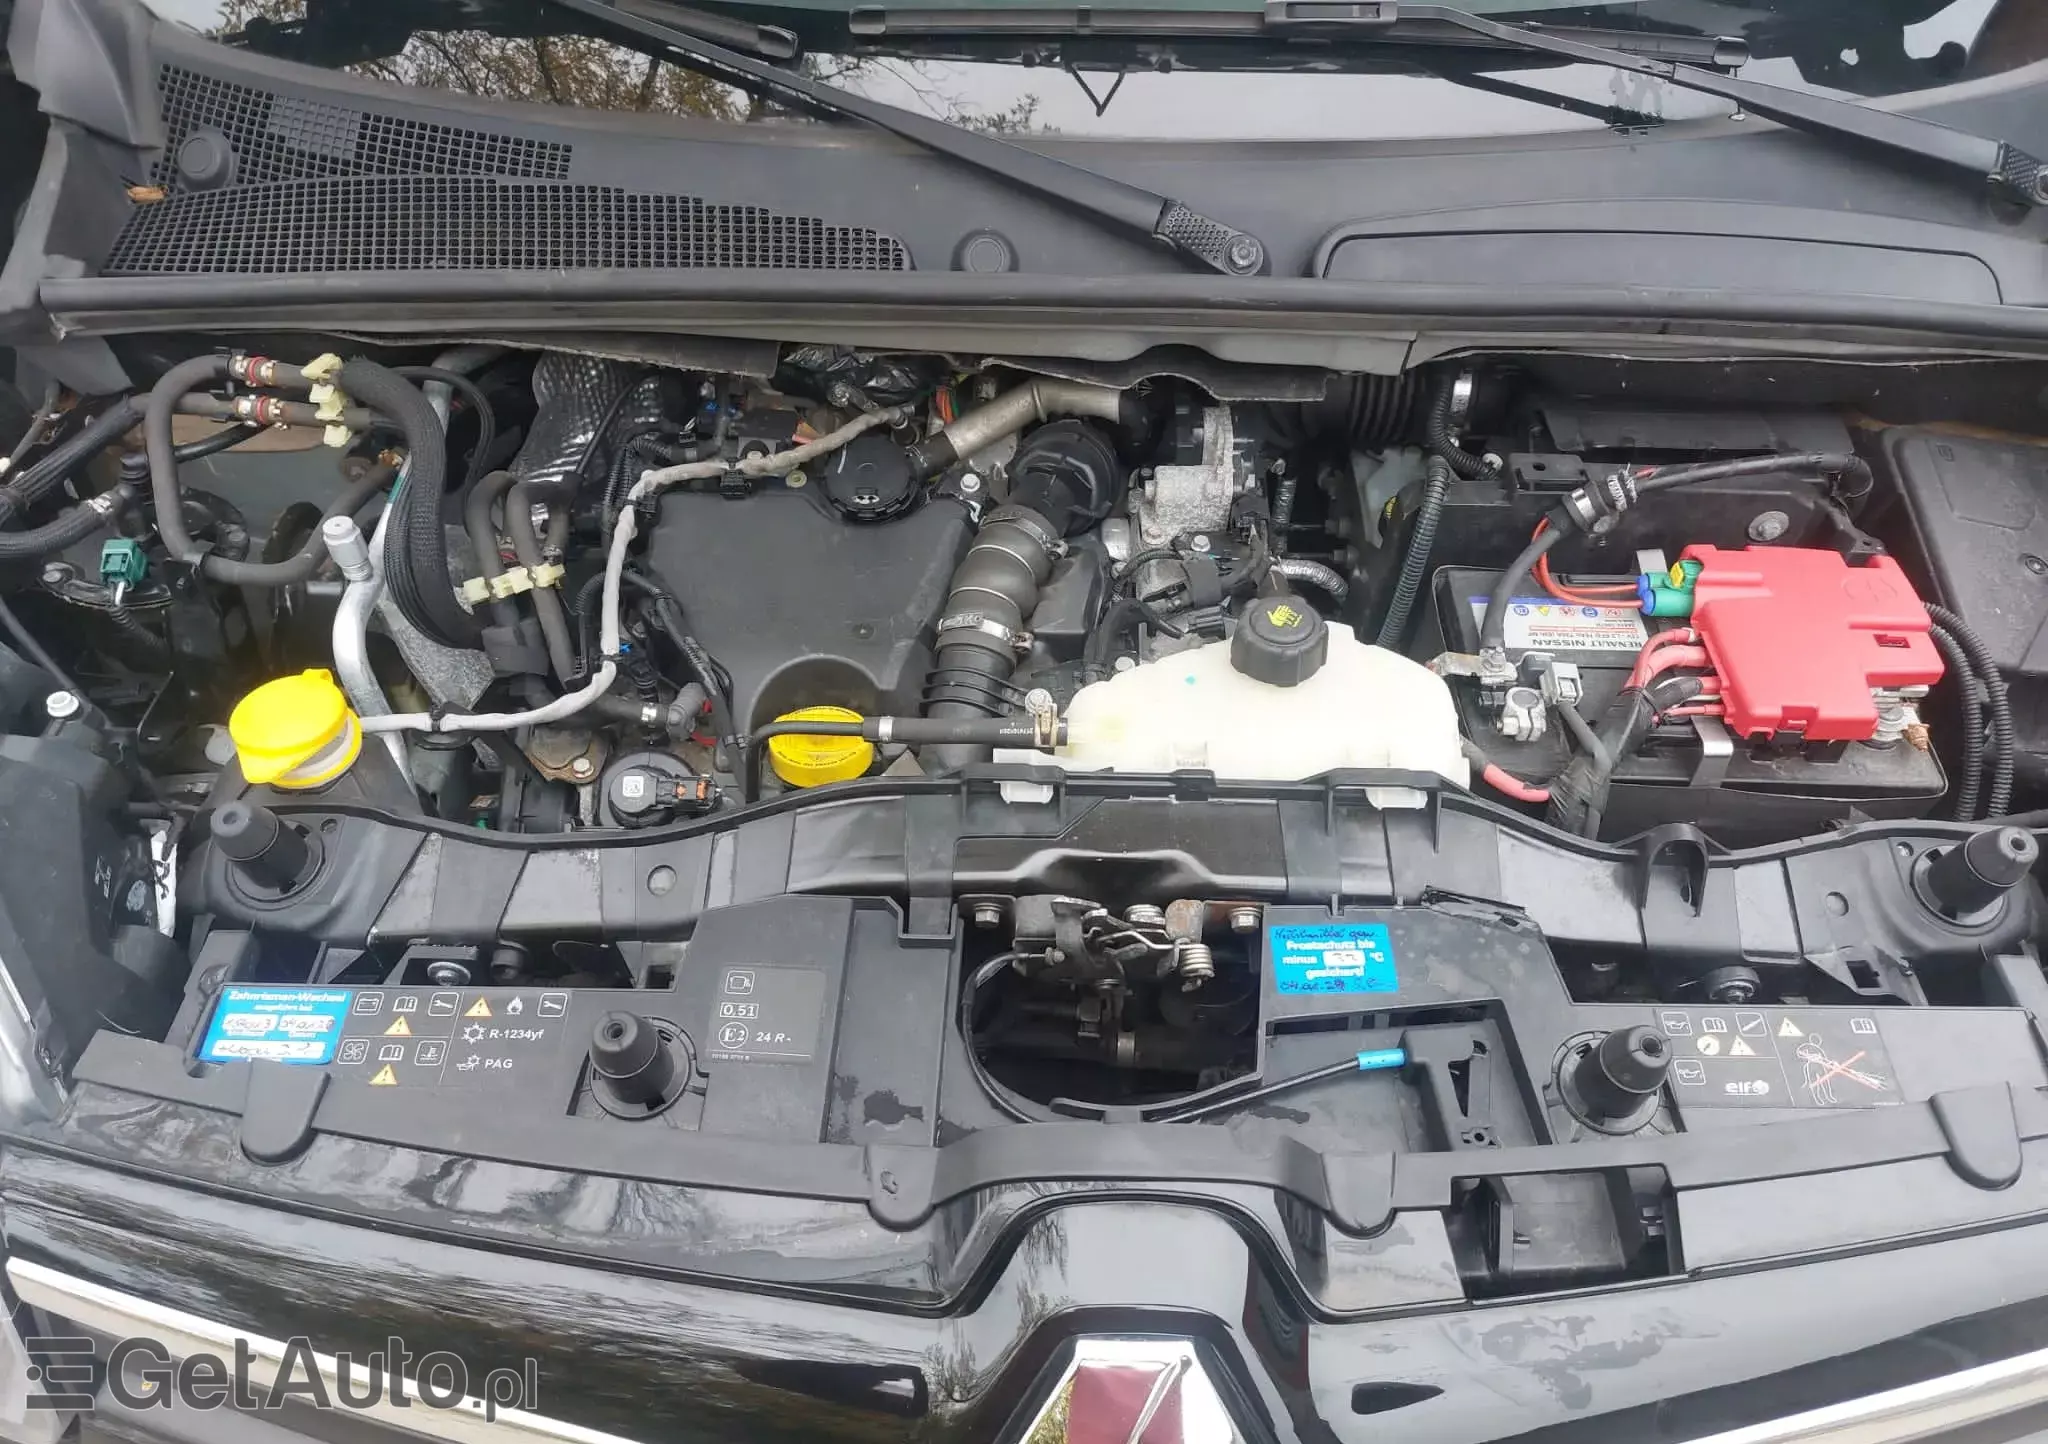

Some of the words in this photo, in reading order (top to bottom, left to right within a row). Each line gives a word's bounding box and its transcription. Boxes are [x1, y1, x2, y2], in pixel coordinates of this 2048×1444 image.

[1532, 638, 1586, 647] NISSAN
[1590, 640, 1642, 648] RENAULT
[1282, 955, 1318, 965] minus
[489, 1028, 544, 1041] R-1234yf
[756, 1031, 771, 1042] 24
[484, 1058, 513, 1069] PAG
